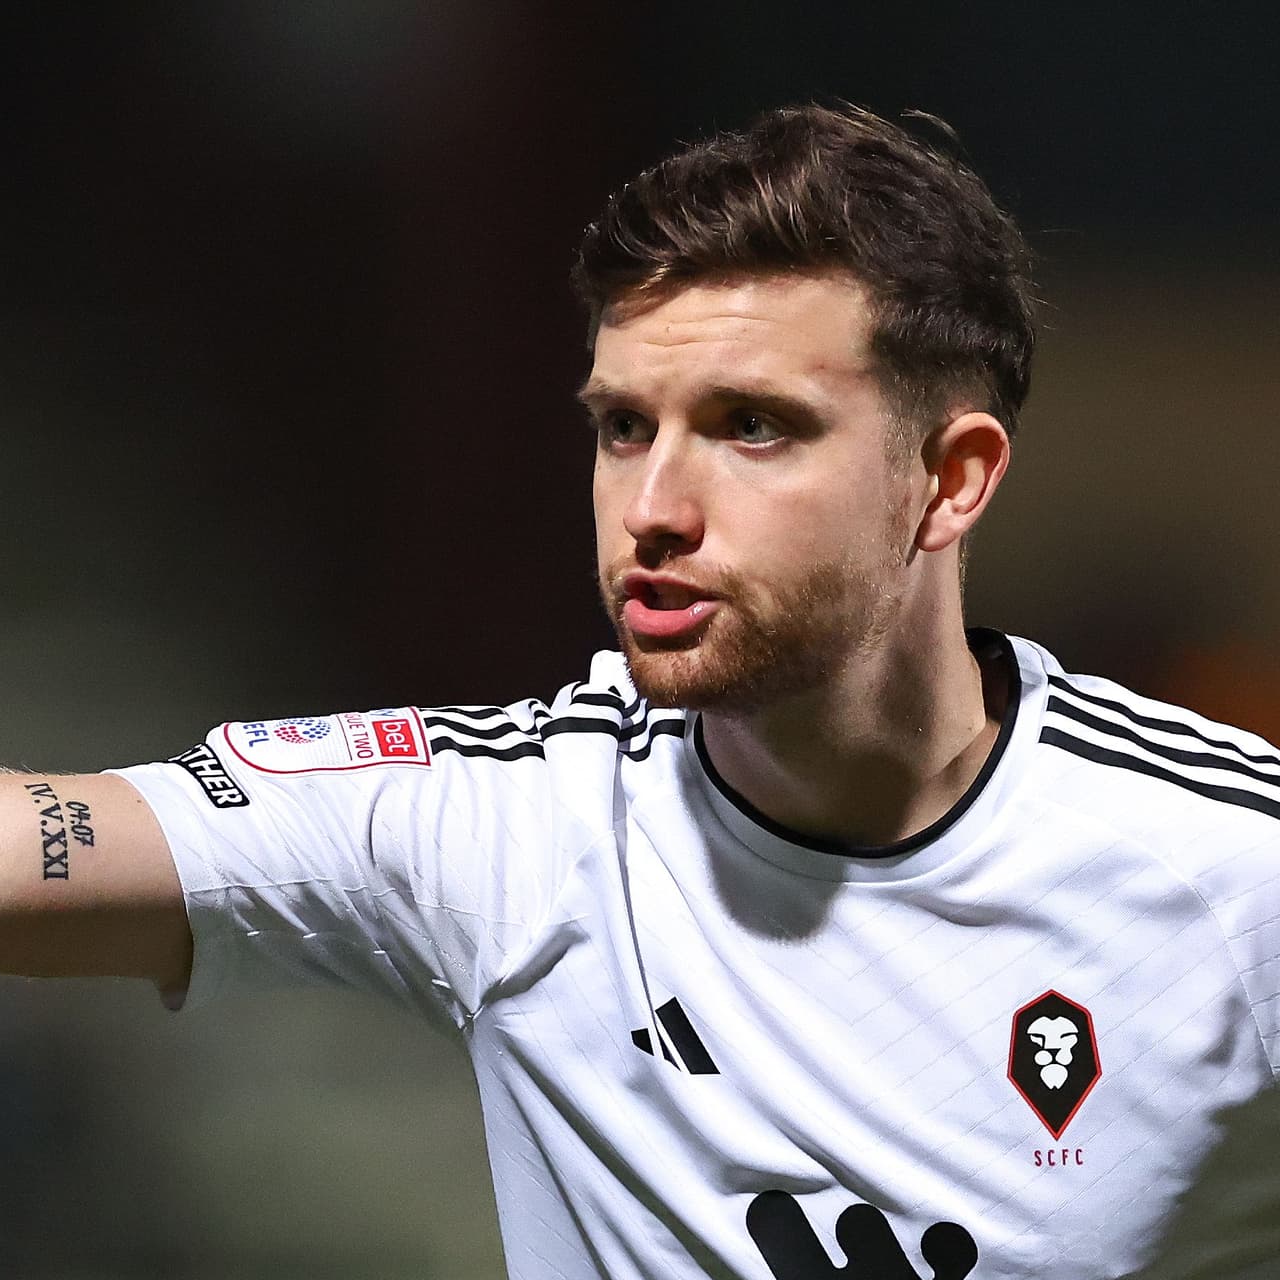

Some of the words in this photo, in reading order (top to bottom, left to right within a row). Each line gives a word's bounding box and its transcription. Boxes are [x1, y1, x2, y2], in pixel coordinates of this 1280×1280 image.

[242, 722, 270, 748] EFL
[351, 731, 374, 759] TWO
[382, 720, 411, 753] bet
